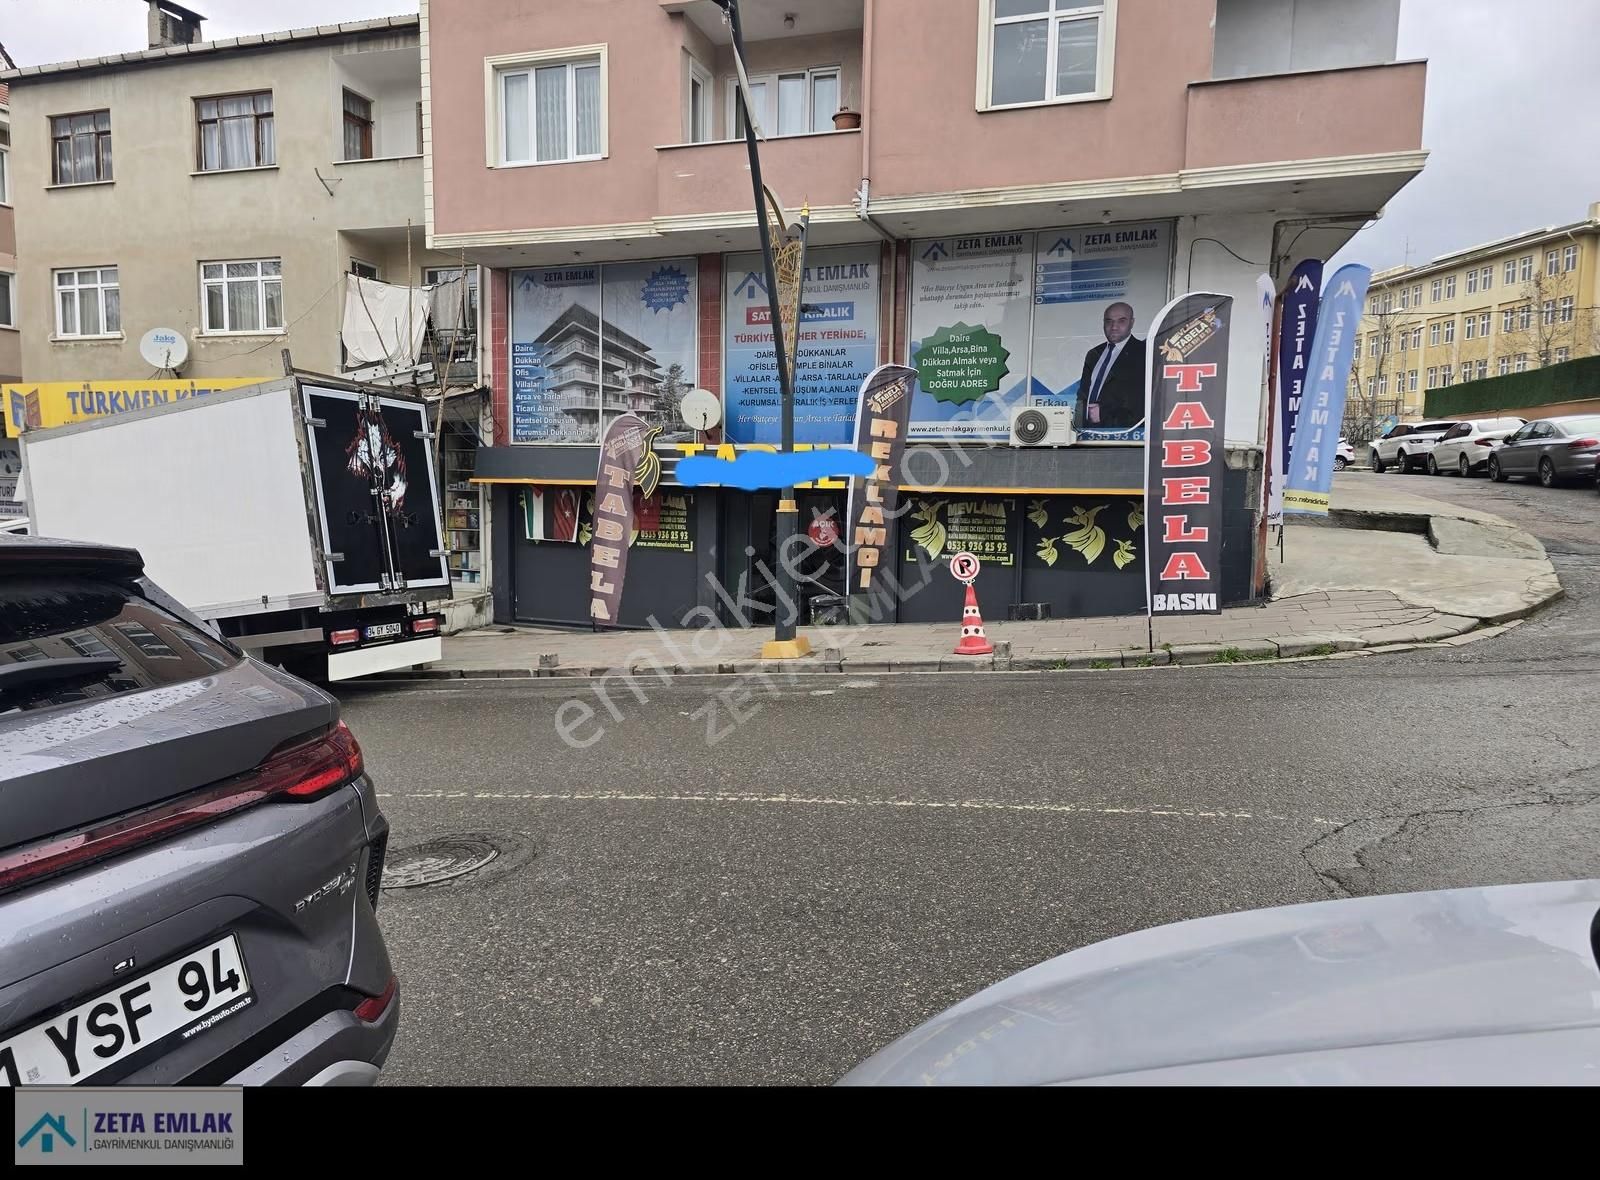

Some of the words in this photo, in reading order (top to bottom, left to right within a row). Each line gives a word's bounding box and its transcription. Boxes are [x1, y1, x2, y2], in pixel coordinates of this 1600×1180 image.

[957, 239, 981, 250] ZETA
[984, 235, 1023, 248] EMLAK
[1084, 233, 1111, 246] ZETA
[1115, 229, 1158, 243] EMLAK
[544, 272, 563, 282] ZETA
[565, 270, 594, 281] EMLAK
[817, 263, 870, 281] EMLAK
[948, 333, 971, 343] Daire
[1174, 321, 1209, 349] TABELA
[818, 360, 854, 369] BİNALAR
[921, 358, 951, 367] Dükkan
[953, 357, 977, 366] Almak
[979, 356, 998, 366] veya
[936, 369, 966, 378] Satmak
[967, 366, 982, 377] İçin
[929, 379, 959, 389] DOĞRU
[960, 379, 988, 388] ADRES
[515, 393, 532, 401] Arsa
[1160, 362, 1218, 581] TABELA
[680, 531, 689, 540] 93
[590, 464, 630, 620] TABELA
[946, 540, 967, 551] 0535
[968, 541, 983, 552] 936
[985, 541, 996, 552] 25
[996, 542, 1008, 552] 93
[1152, 593, 1218, 612] BASKI
[368, 627, 376, 636] 34
[376, 626, 384, 635] GY
[44, 981, 153, 1079] YSF
[177, 947, 242, 1012] 94
[182, 996, 252, 1039] www.bydauto.com.tr
